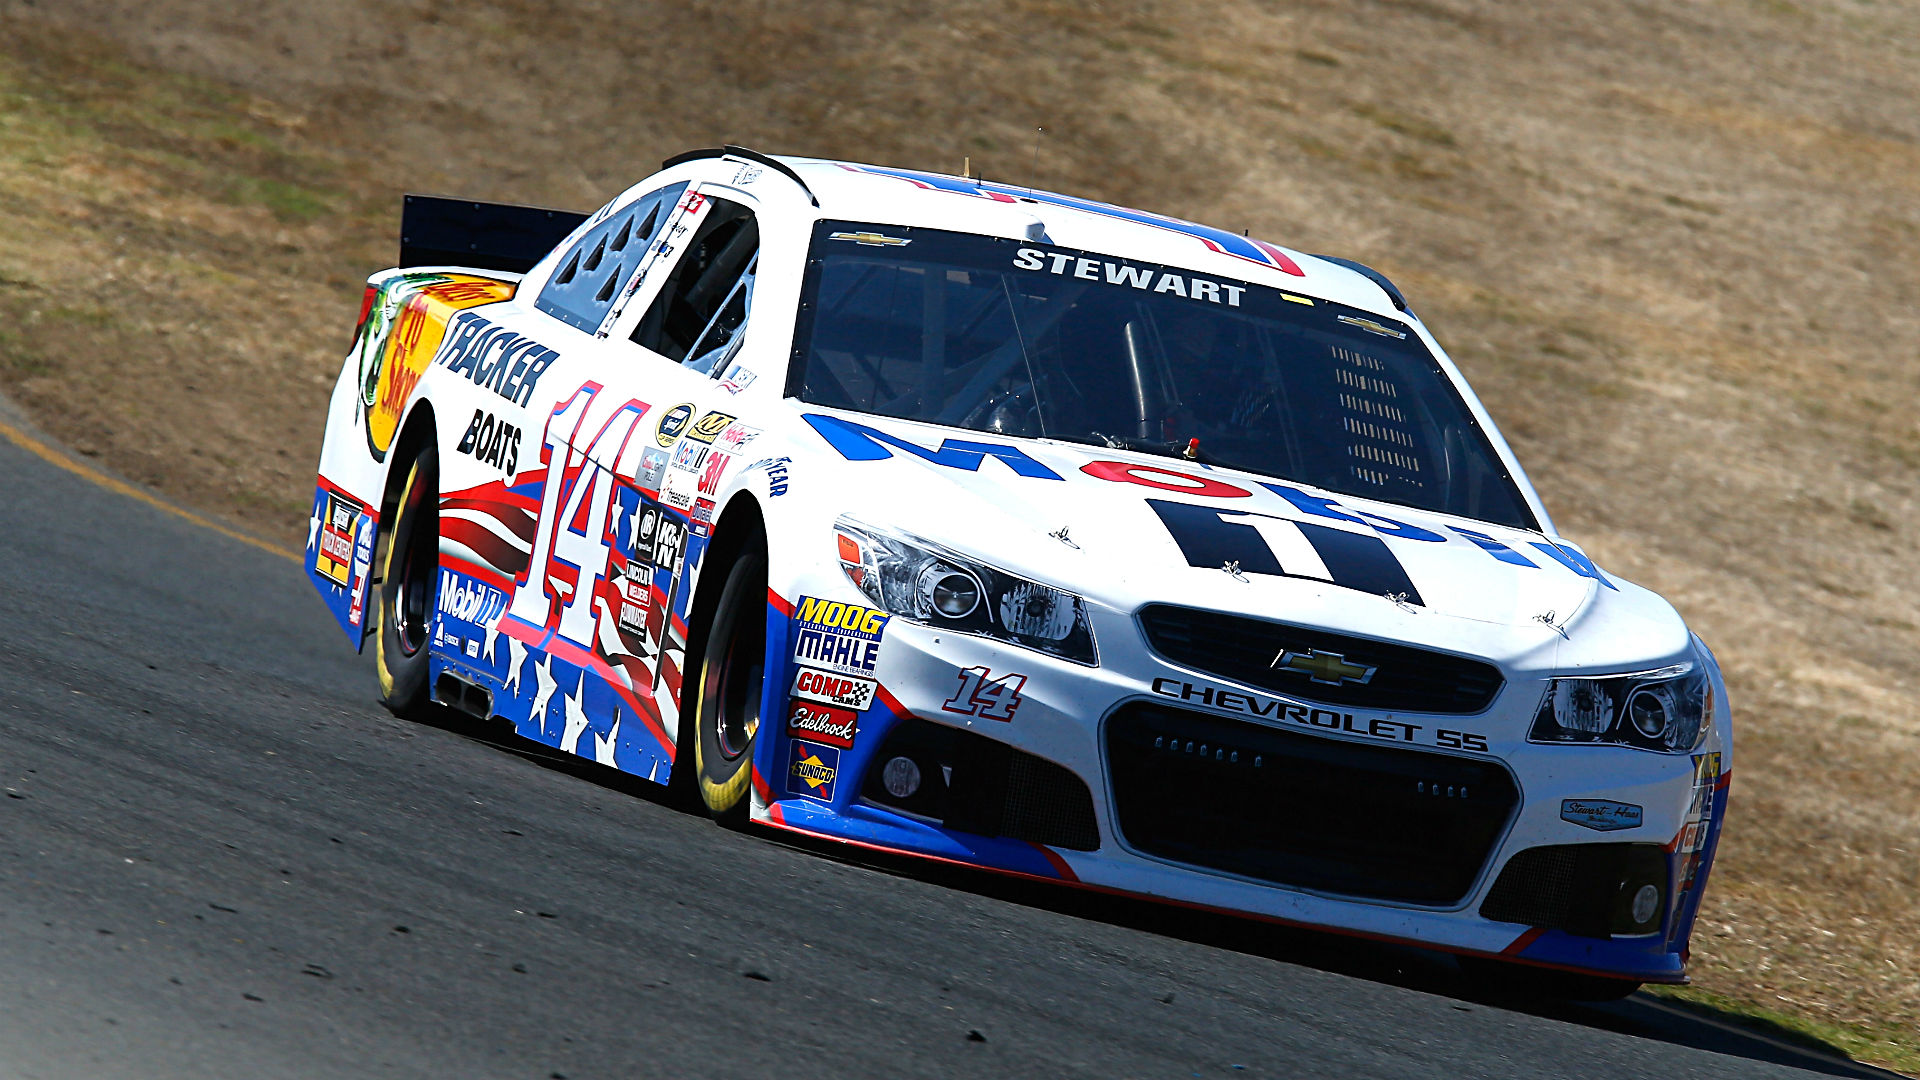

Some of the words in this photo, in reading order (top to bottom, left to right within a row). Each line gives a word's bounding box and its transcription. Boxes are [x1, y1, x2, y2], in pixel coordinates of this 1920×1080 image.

[1012, 247, 1246, 308] STEWART
[435, 312, 560, 409] TRACKER
[457, 408, 521, 477] BOATS
[697, 451, 729, 496] 3M
[504, 380, 653, 652] 14
[627, 562, 649, 586] LINCOLN
[438, 569, 486, 623] Mobil
[629, 583, 649, 603] WELDERS
[796, 597, 889, 634] MOOG
[798, 621, 828, 632] STEERING
[836, 628, 874, 640] SUSPENSION
[796, 633, 879, 671] MAHLE
[832, 663, 850, 672] ENGINE
[849, 666, 874, 678] BEARINGS
[797, 671, 853, 698] COMP
[832, 695, 861, 706] CAMS
[942, 665, 1027, 723] 14
[790, 708, 853, 739] Edelbrock
[1151, 677, 1422, 741] CHEVROLET
[1435, 728, 1489, 753] SS
[793, 762, 833, 783] SUNOCO
